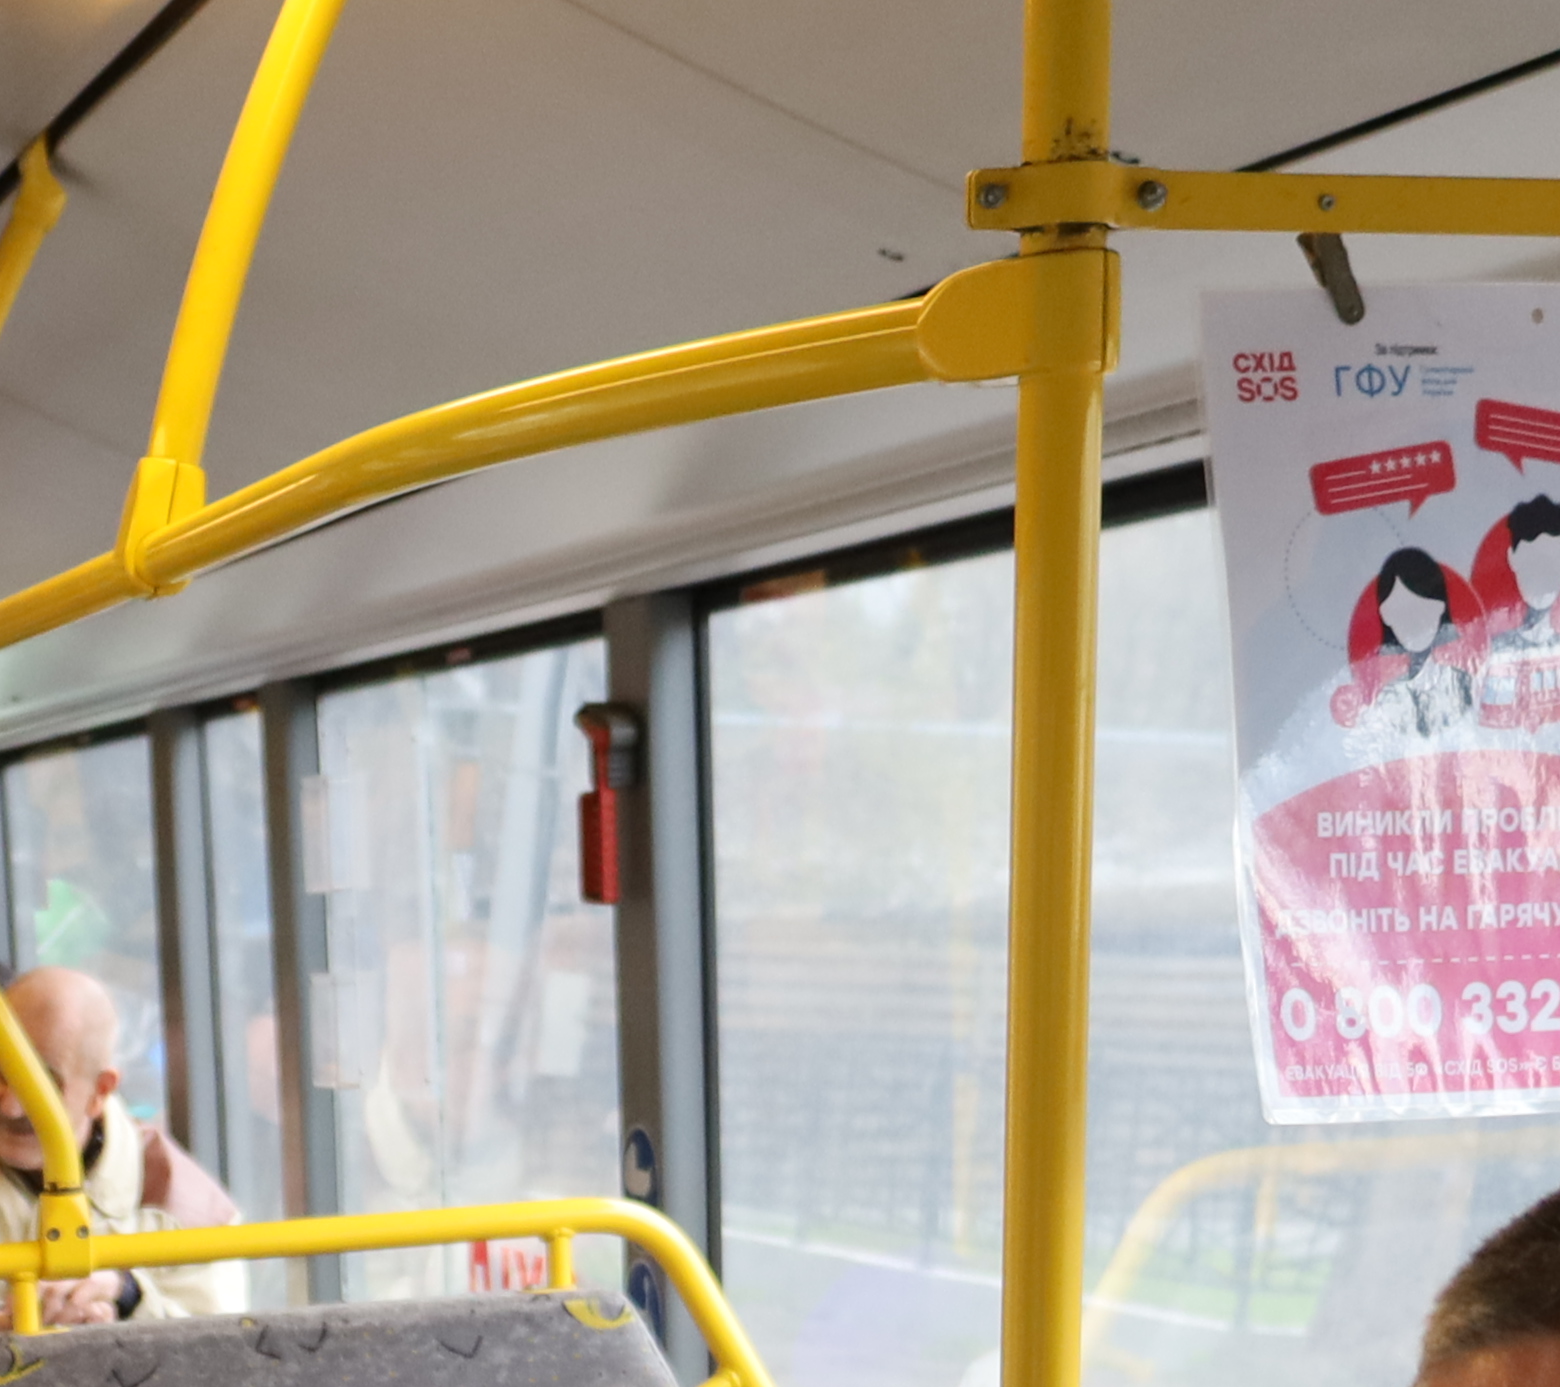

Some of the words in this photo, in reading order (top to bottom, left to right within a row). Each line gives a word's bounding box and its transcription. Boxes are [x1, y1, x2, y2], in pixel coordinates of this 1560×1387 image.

[1232, 351, 1296, 373] СХІД
[1237, 376, 1298, 402] SOS
[1334, 363, 1411, 398] ГФУ
[1317, 810, 1453, 838] ВИНИКЛИ
[1329, 852, 1380, 881] ПІД
[1387, 850, 1445, 877] ЧАС
[1276, 908, 1411, 938] ДЗВОНІТЬ
[1420, 906, 1458, 932] НА
[1280, 987, 1317, 1042] 0
[1335, 983, 1442, 1041] 800
